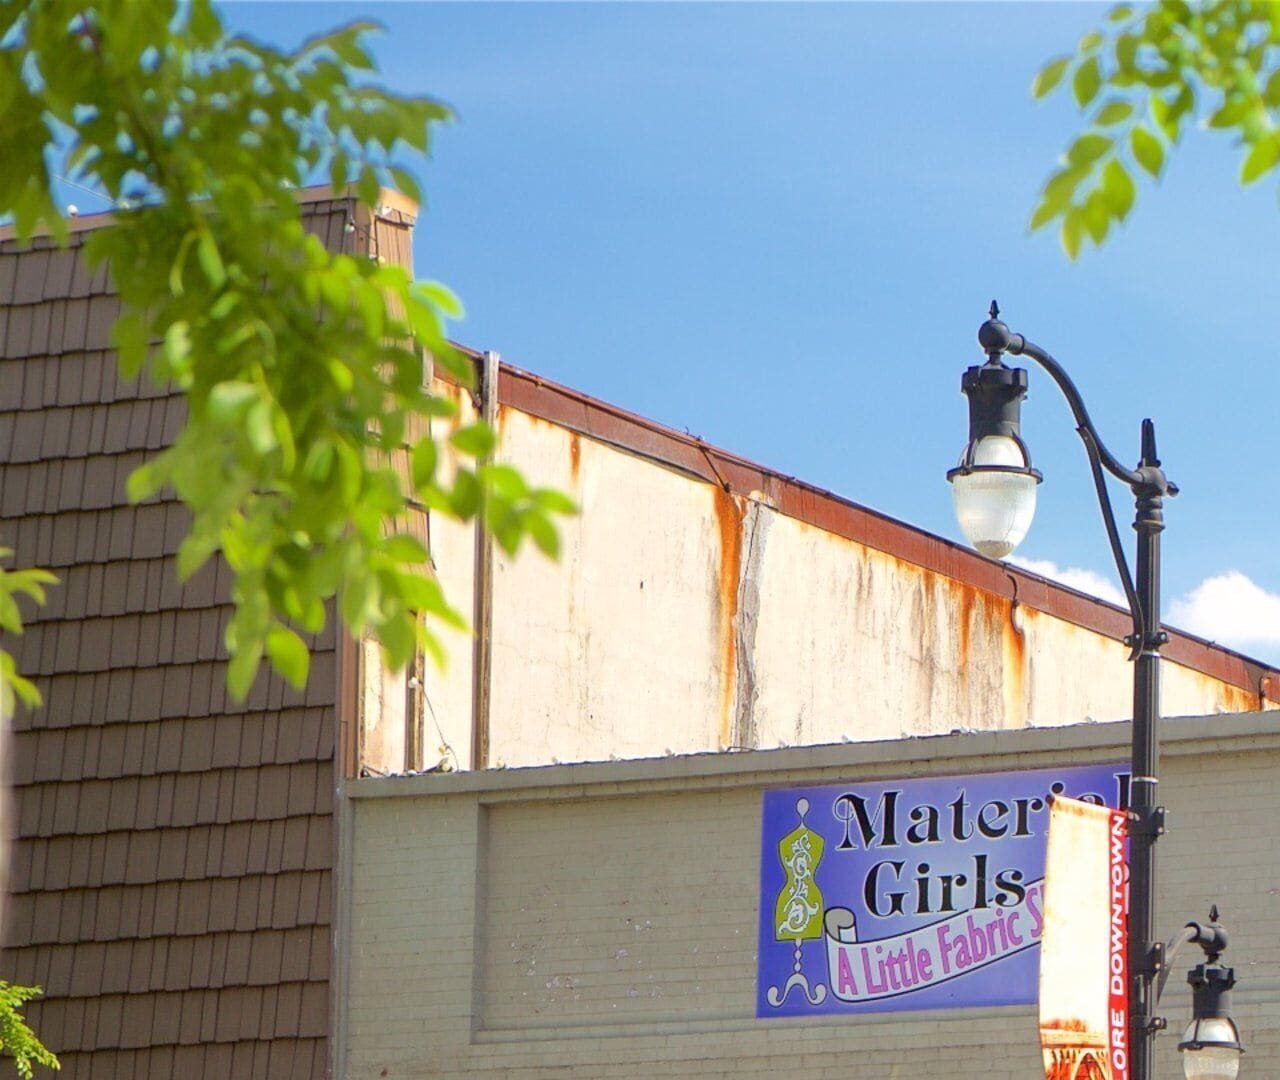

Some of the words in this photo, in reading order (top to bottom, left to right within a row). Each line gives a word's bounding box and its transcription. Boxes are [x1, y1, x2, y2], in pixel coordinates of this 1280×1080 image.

[834, 773, 1131, 850] Materl
[863, 853, 1026, 918] Girls
[1110, 815, 1126, 996] DOWNTOWN
[838, 947, 857, 996] A
[862, 937, 933, 995] Little
[936, 907, 1022, 975] Fabric
